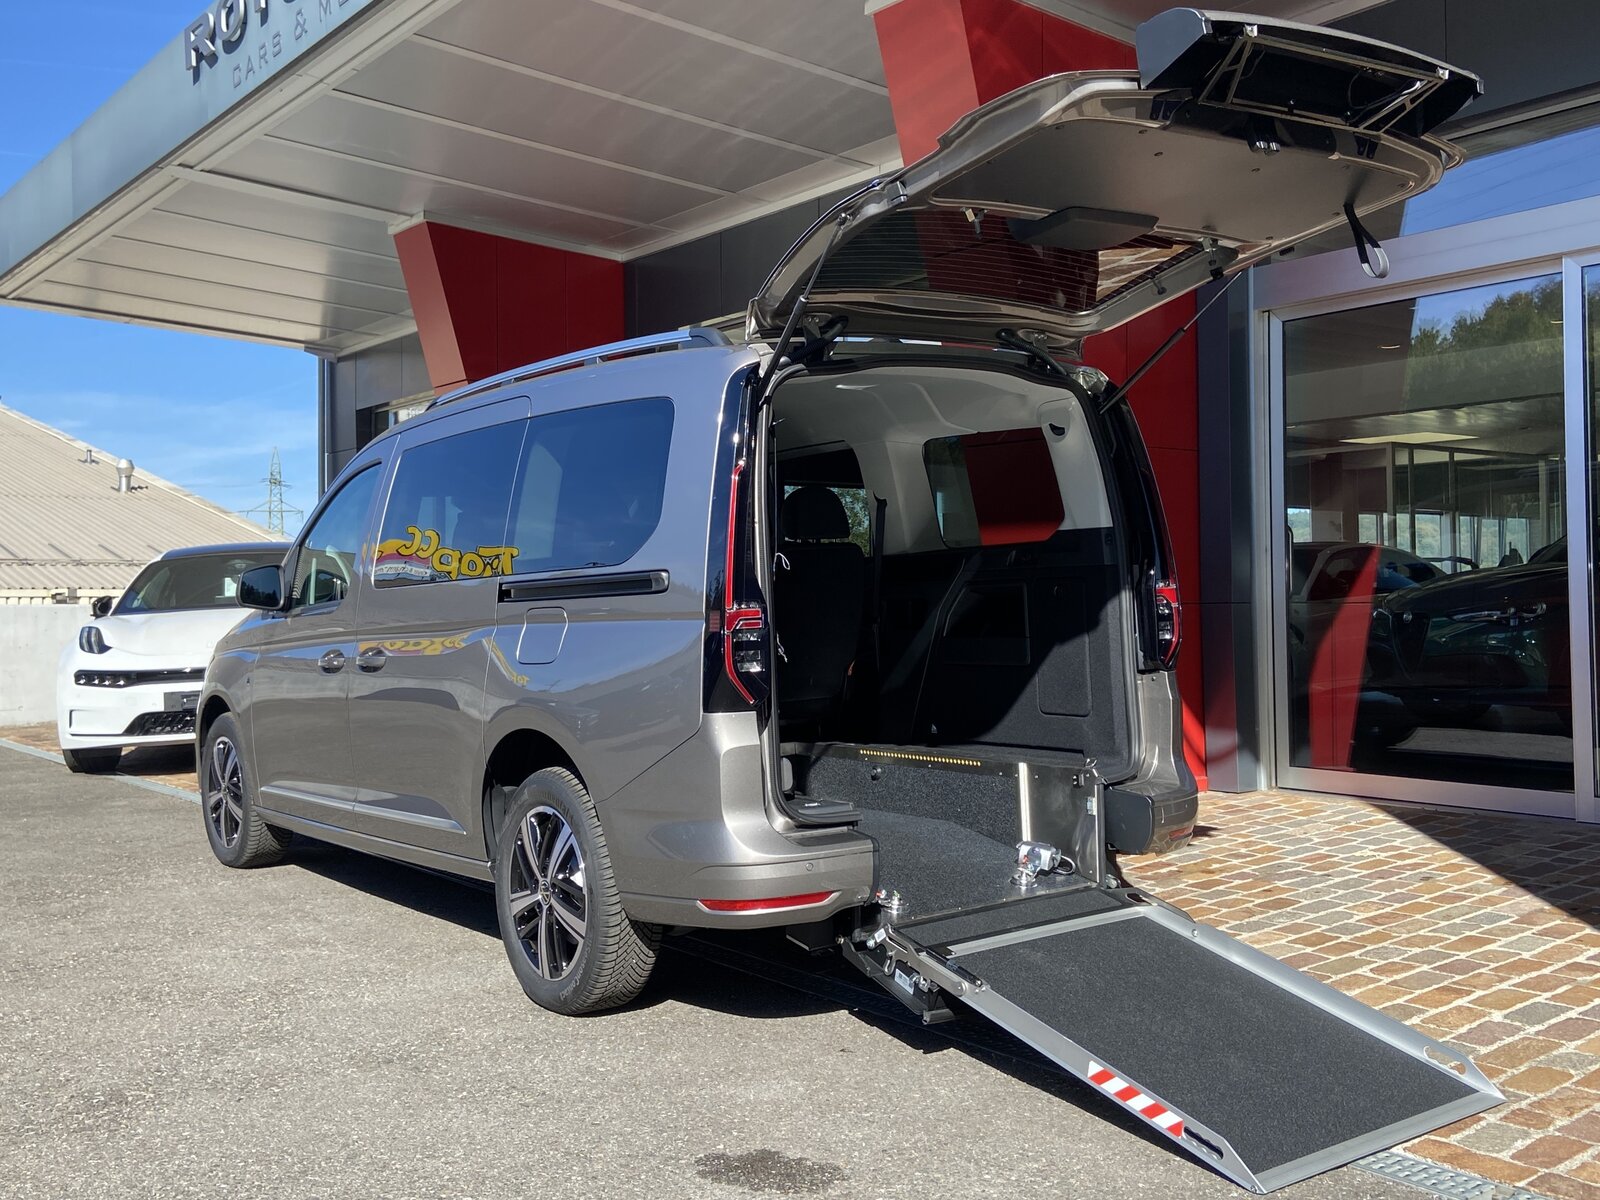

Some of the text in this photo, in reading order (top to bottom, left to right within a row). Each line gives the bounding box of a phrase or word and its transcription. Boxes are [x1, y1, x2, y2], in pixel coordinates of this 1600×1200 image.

[233, 0, 349, 88] CARS & M
